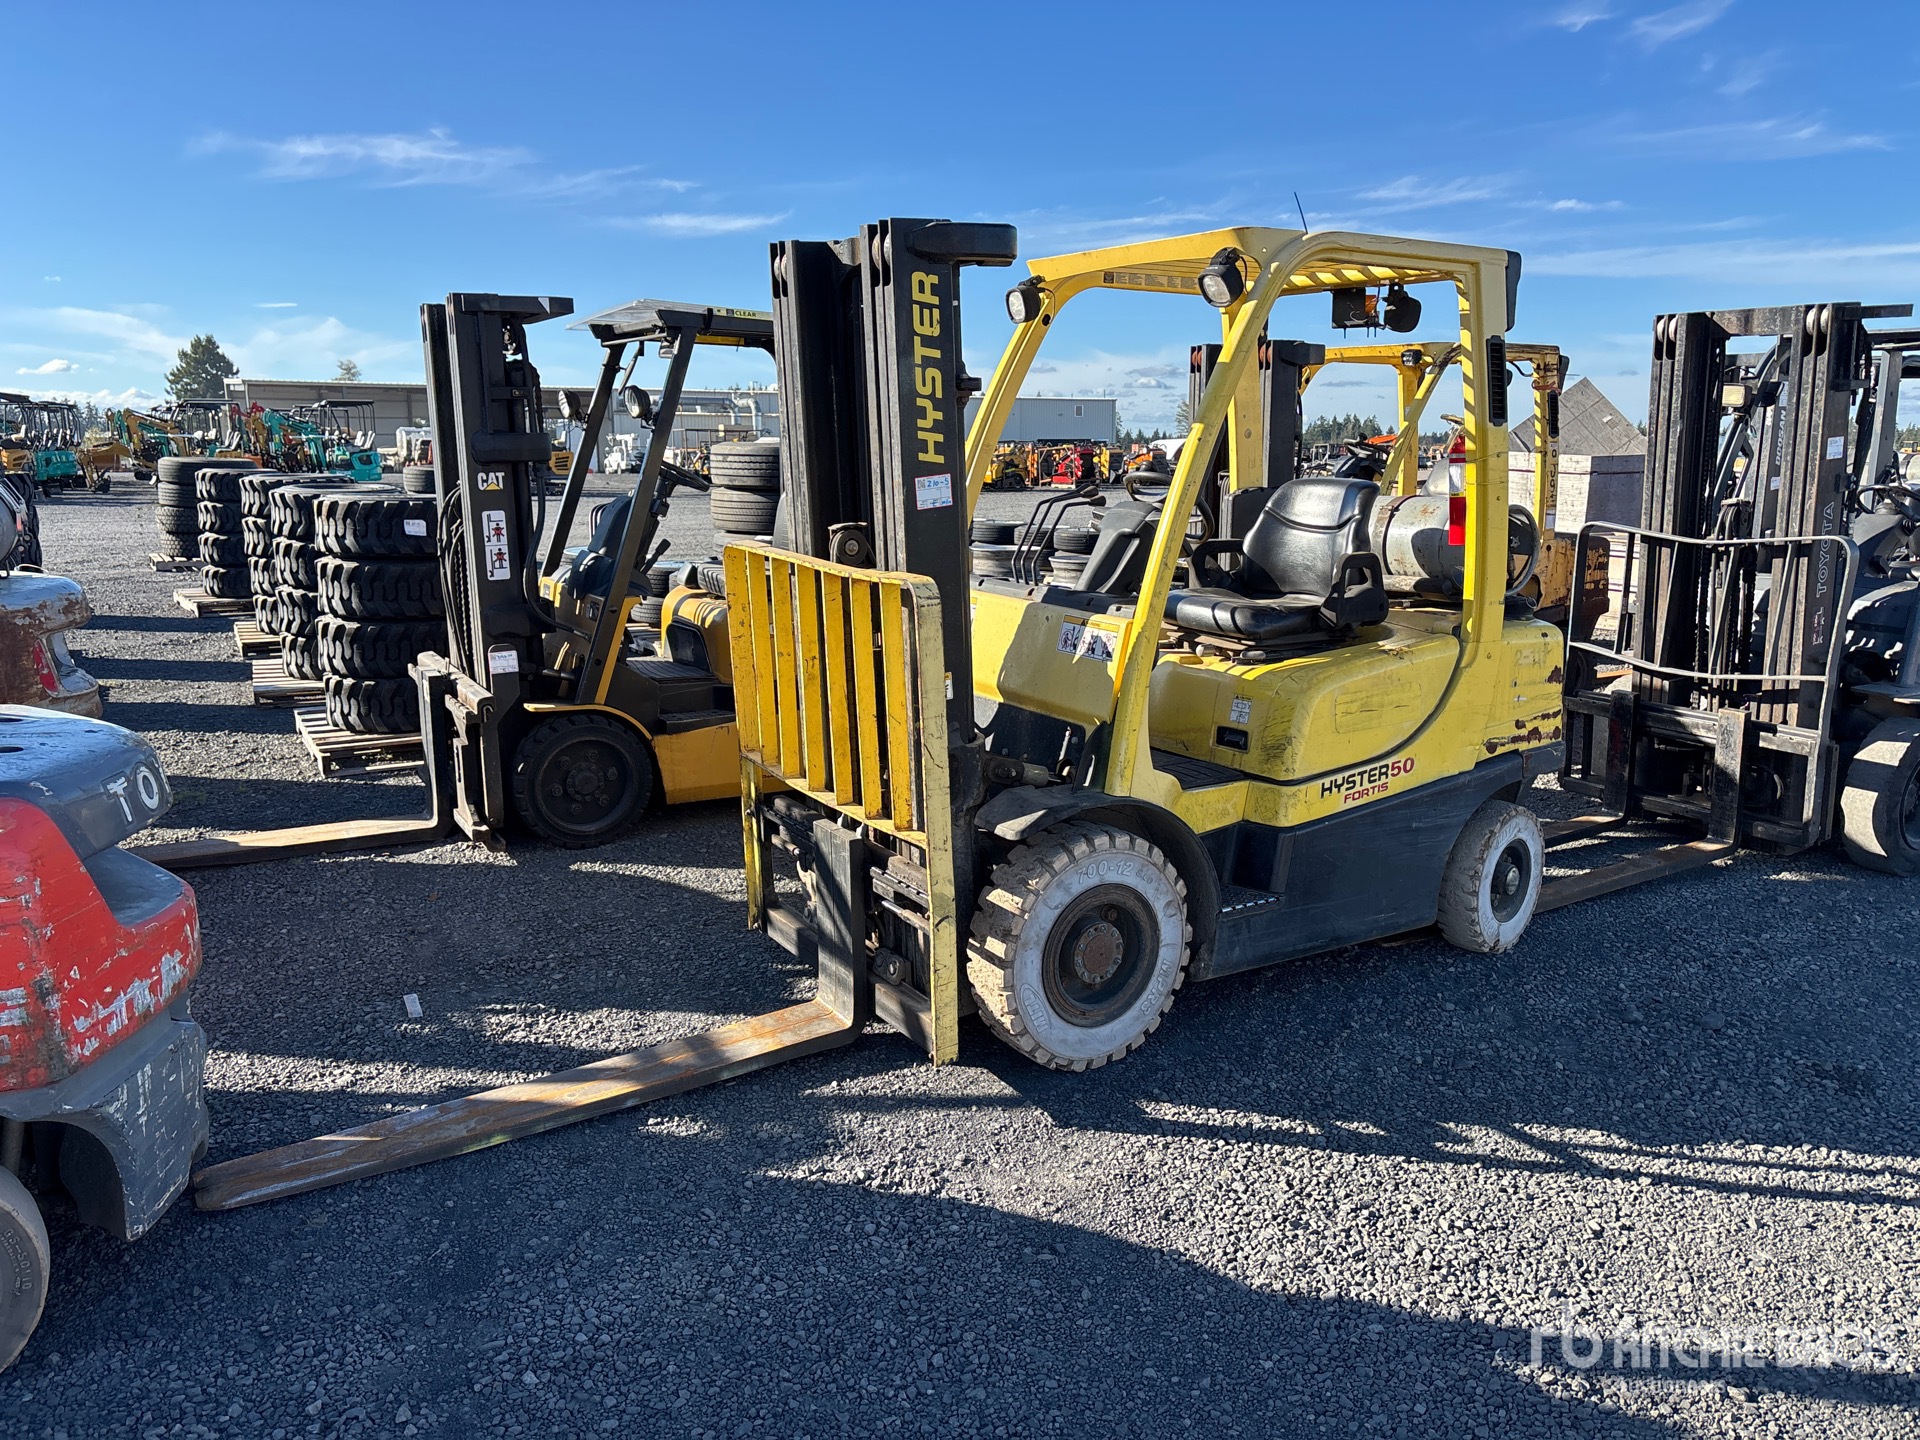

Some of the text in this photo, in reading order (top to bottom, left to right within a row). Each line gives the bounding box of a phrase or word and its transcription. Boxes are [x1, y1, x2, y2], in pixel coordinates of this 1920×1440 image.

[734, 310, 757, 318] CLEAR
[911, 271, 945, 464] HYSTER
[1775, 409, 1787, 466] DOOSAN
[477, 471, 505, 491] CAT
[1816, 501, 1835, 598] TOYOTA
[106, 758, 168, 823] TO
[1320, 757, 1415, 799] HYSTER 50
[1343, 781, 1389, 804] FORTIS
[1076, 860, 1134, 885] 700-12
[1141, 959, 1172, 1016] MPR3
